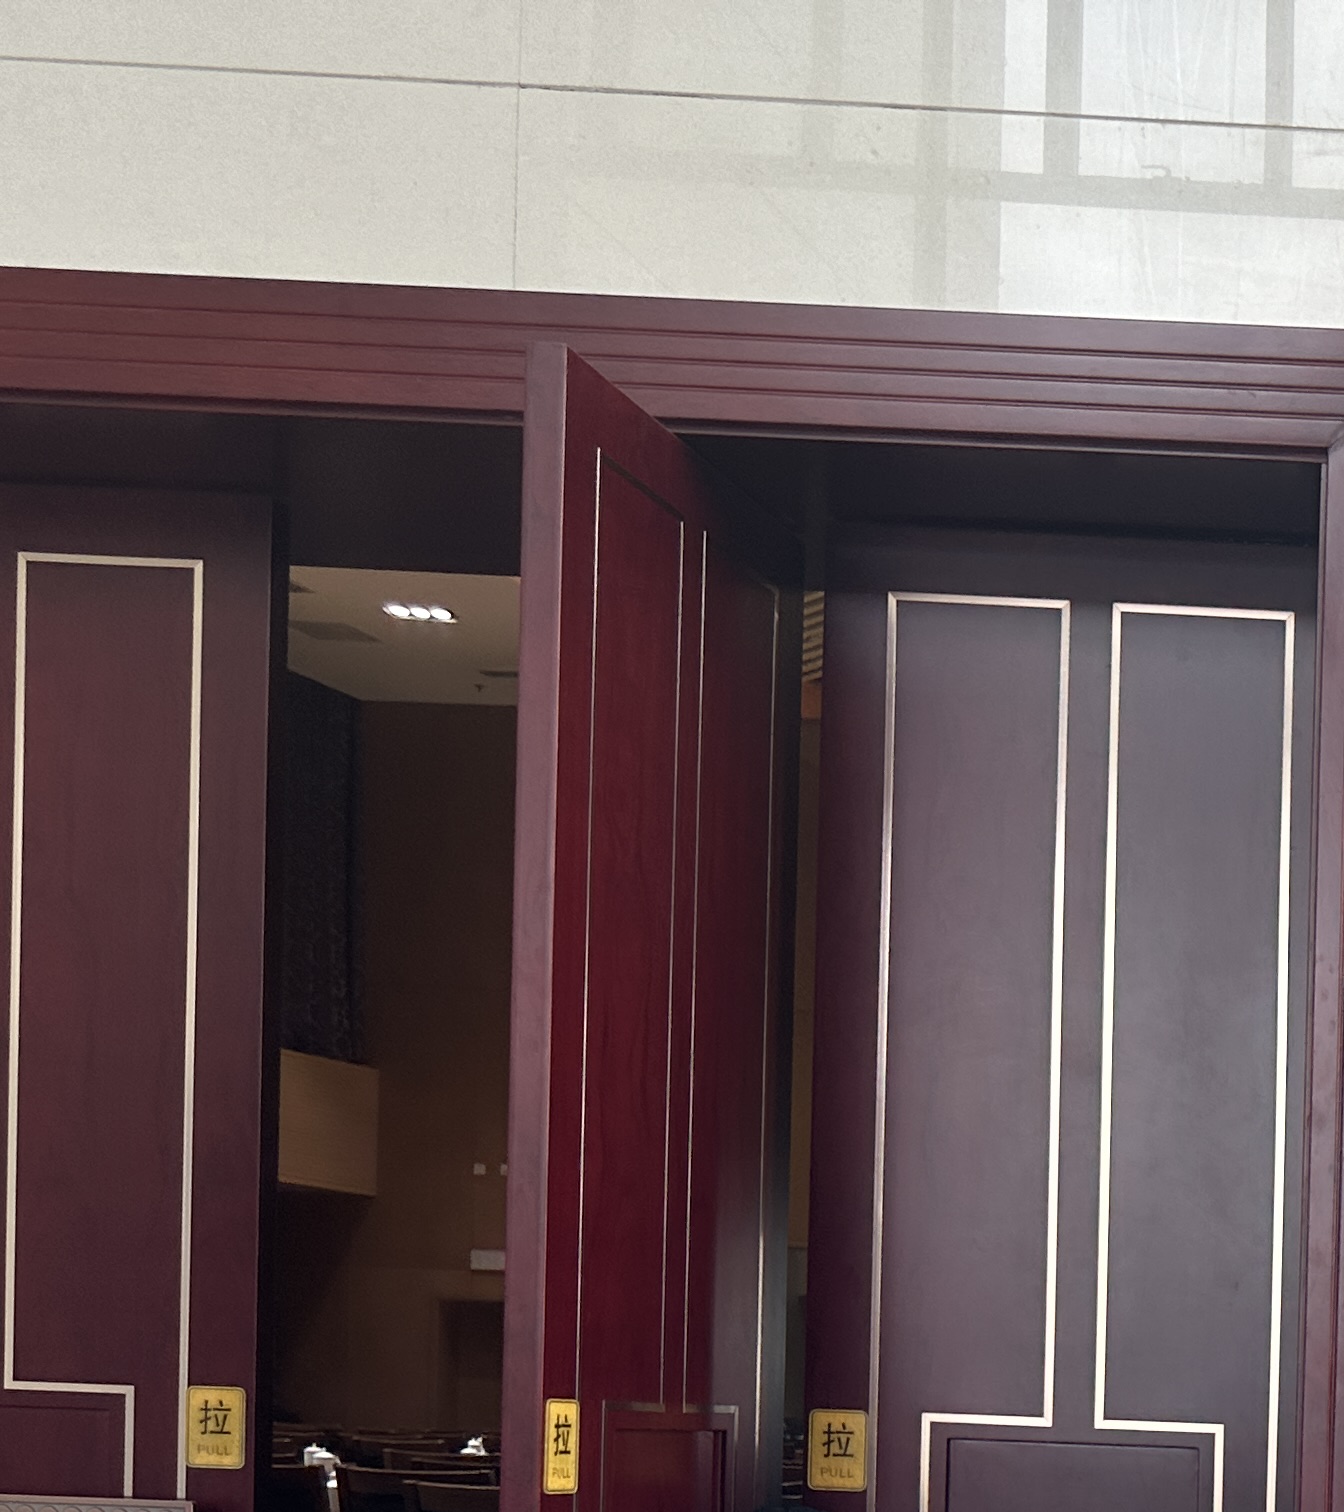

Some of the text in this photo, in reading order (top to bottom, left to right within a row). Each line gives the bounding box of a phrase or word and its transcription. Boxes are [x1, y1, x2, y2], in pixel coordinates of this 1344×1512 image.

[199, 1399, 232, 1435] 拉
[554, 1414, 572, 1456] 拉
[197, 1443, 232, 1456] PULL
[822, 1422, 855, 1458] 拉
[820, 1466, 854, 1479] PULL
